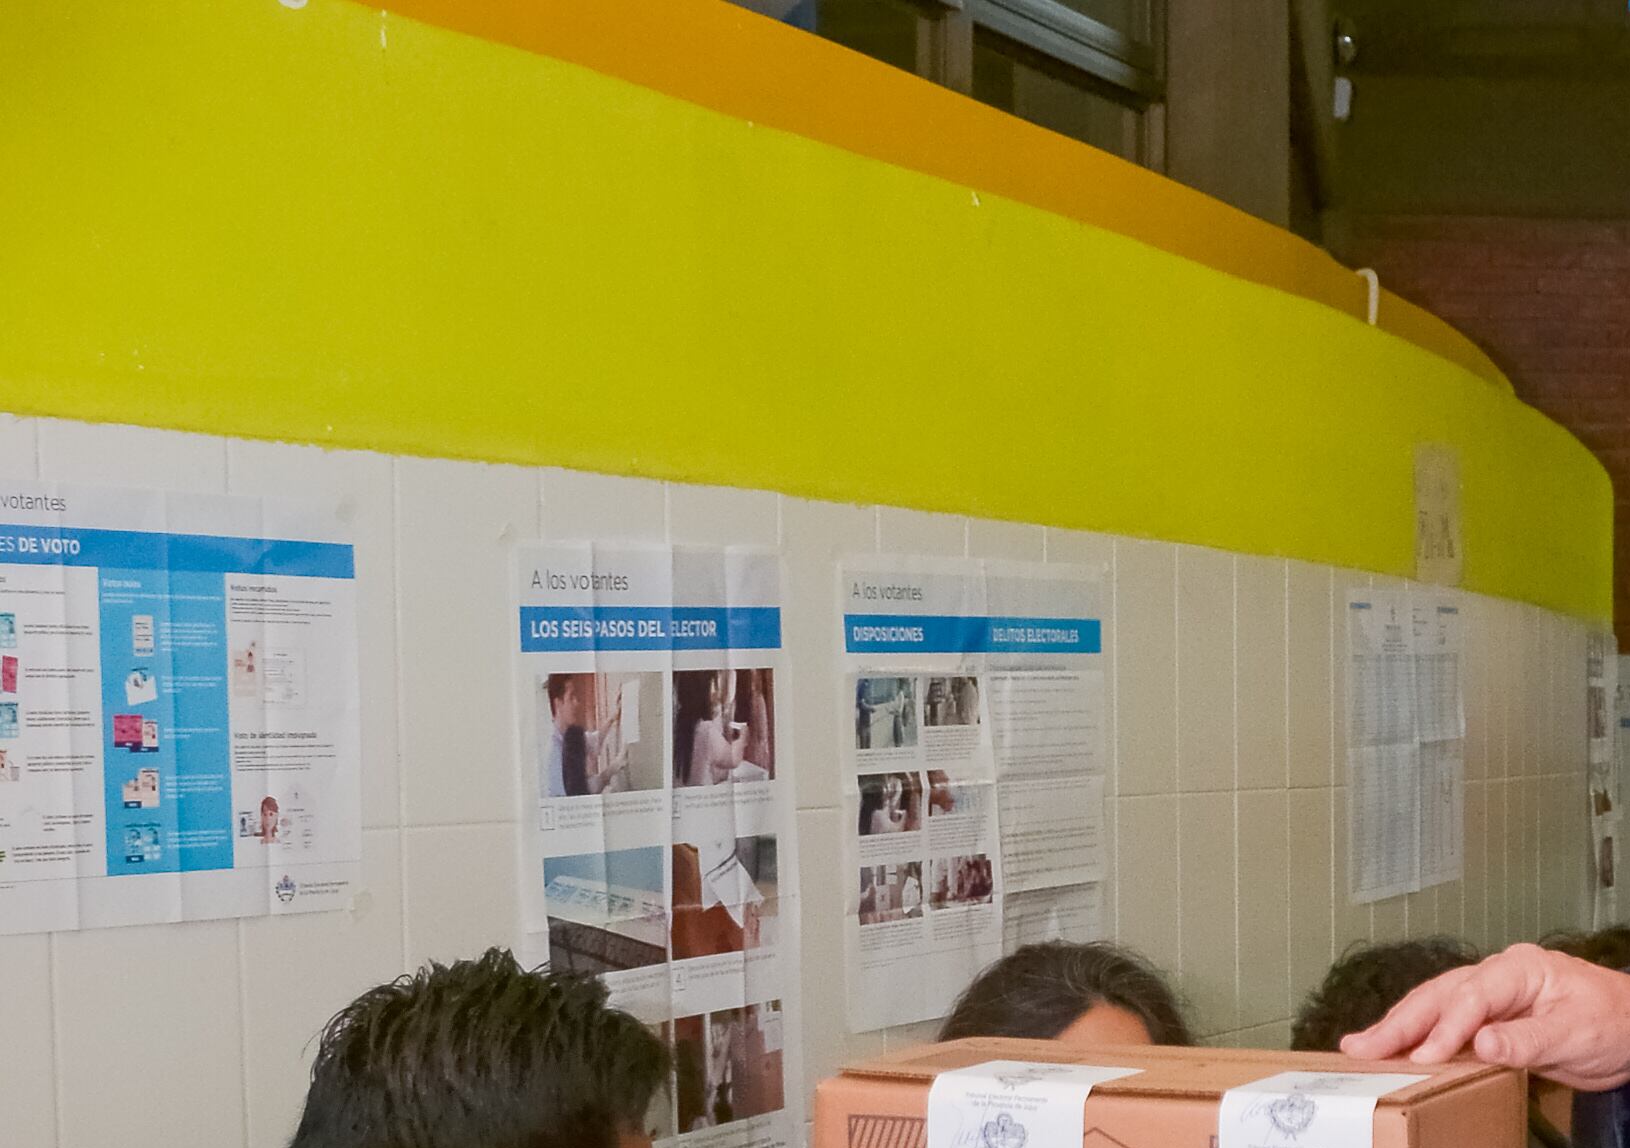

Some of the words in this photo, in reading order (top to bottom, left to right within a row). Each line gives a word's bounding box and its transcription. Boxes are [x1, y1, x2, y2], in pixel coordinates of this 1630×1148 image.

[18, 536, 37, 552] DE
[41, 538, 81, 554] VOTO
[531, 570, 543, 589] A
[547, 569, 566, 590] los
[570, 572, 629, 591] votantes
[853, 583, 860, 597] A
[879, 585, 922, 601] votantes
[531, 620, 558, 638] LOS
[563, 620, 592, 637] SEIS
[638, 620, 665, 637] DEL
[671, 620, 717, 637] ELECTOR
[853, 626, 924, 642] DISPOSICIONES
[993, 628, 1025, 643] DELITOS
[1027, 629, 1079, 643] ELECTORALES
